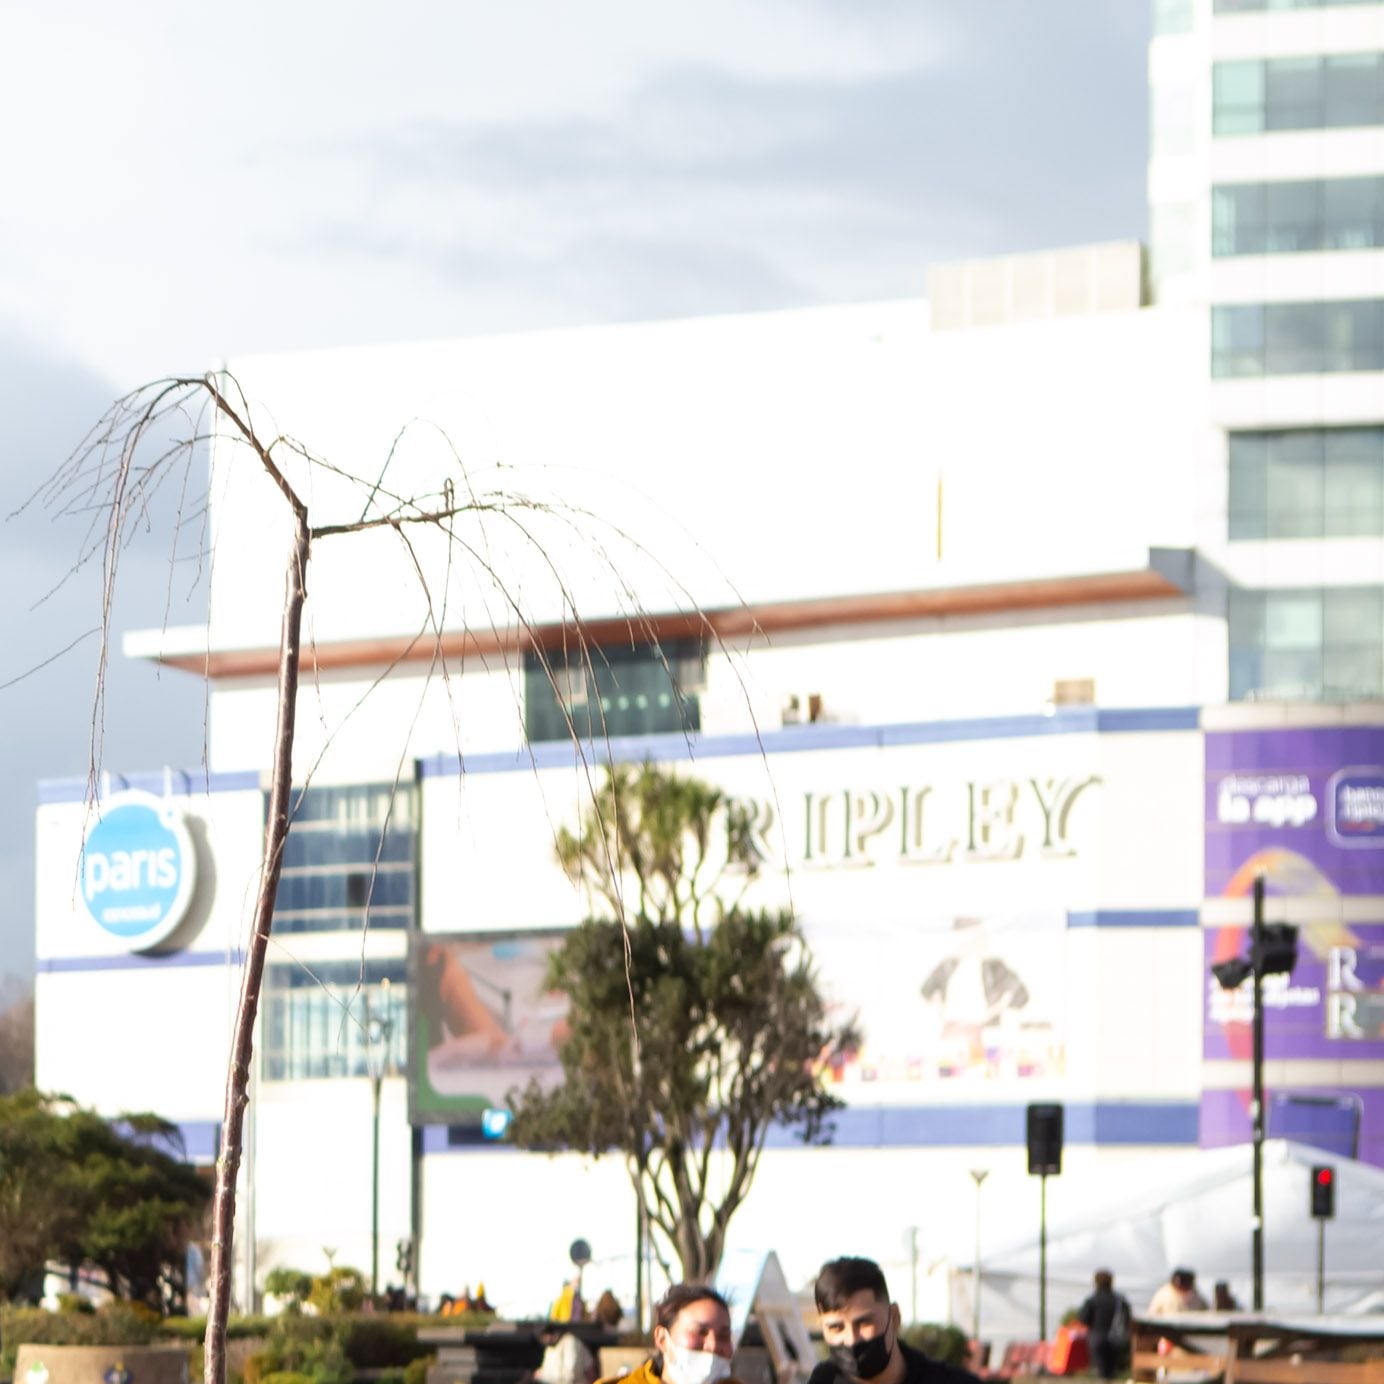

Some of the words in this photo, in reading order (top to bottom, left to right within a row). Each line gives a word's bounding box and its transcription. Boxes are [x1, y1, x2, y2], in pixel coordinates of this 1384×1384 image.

[724, 774, 1103, 873] RIPLEY
[1252, 793, 1318, 828] app
[85, 848, 178, 902] paris
